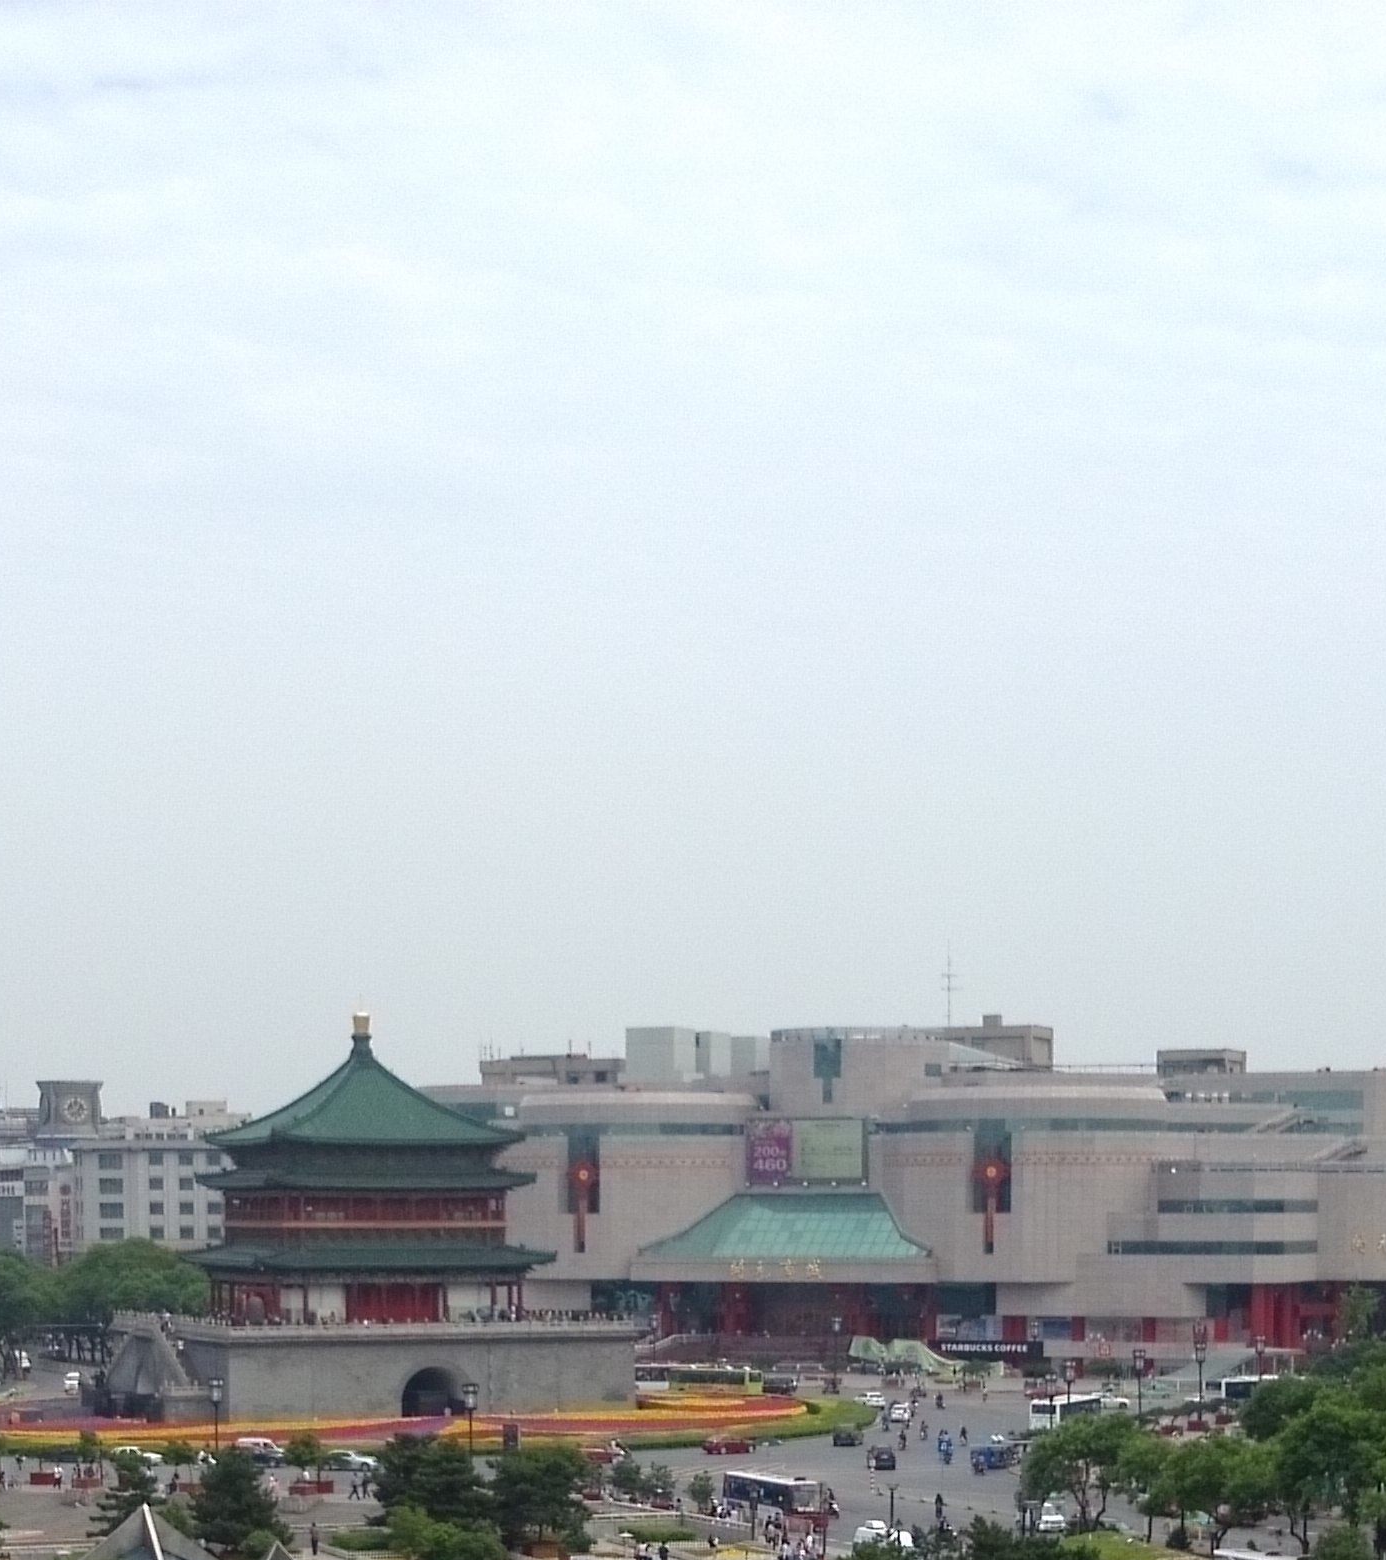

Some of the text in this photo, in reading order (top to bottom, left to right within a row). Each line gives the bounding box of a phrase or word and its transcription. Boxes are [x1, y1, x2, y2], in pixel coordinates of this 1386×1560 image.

[753, 1158, 787, 1171] 460
[940, 1343, 1028, 1353] STARBUCKS COFFEE
